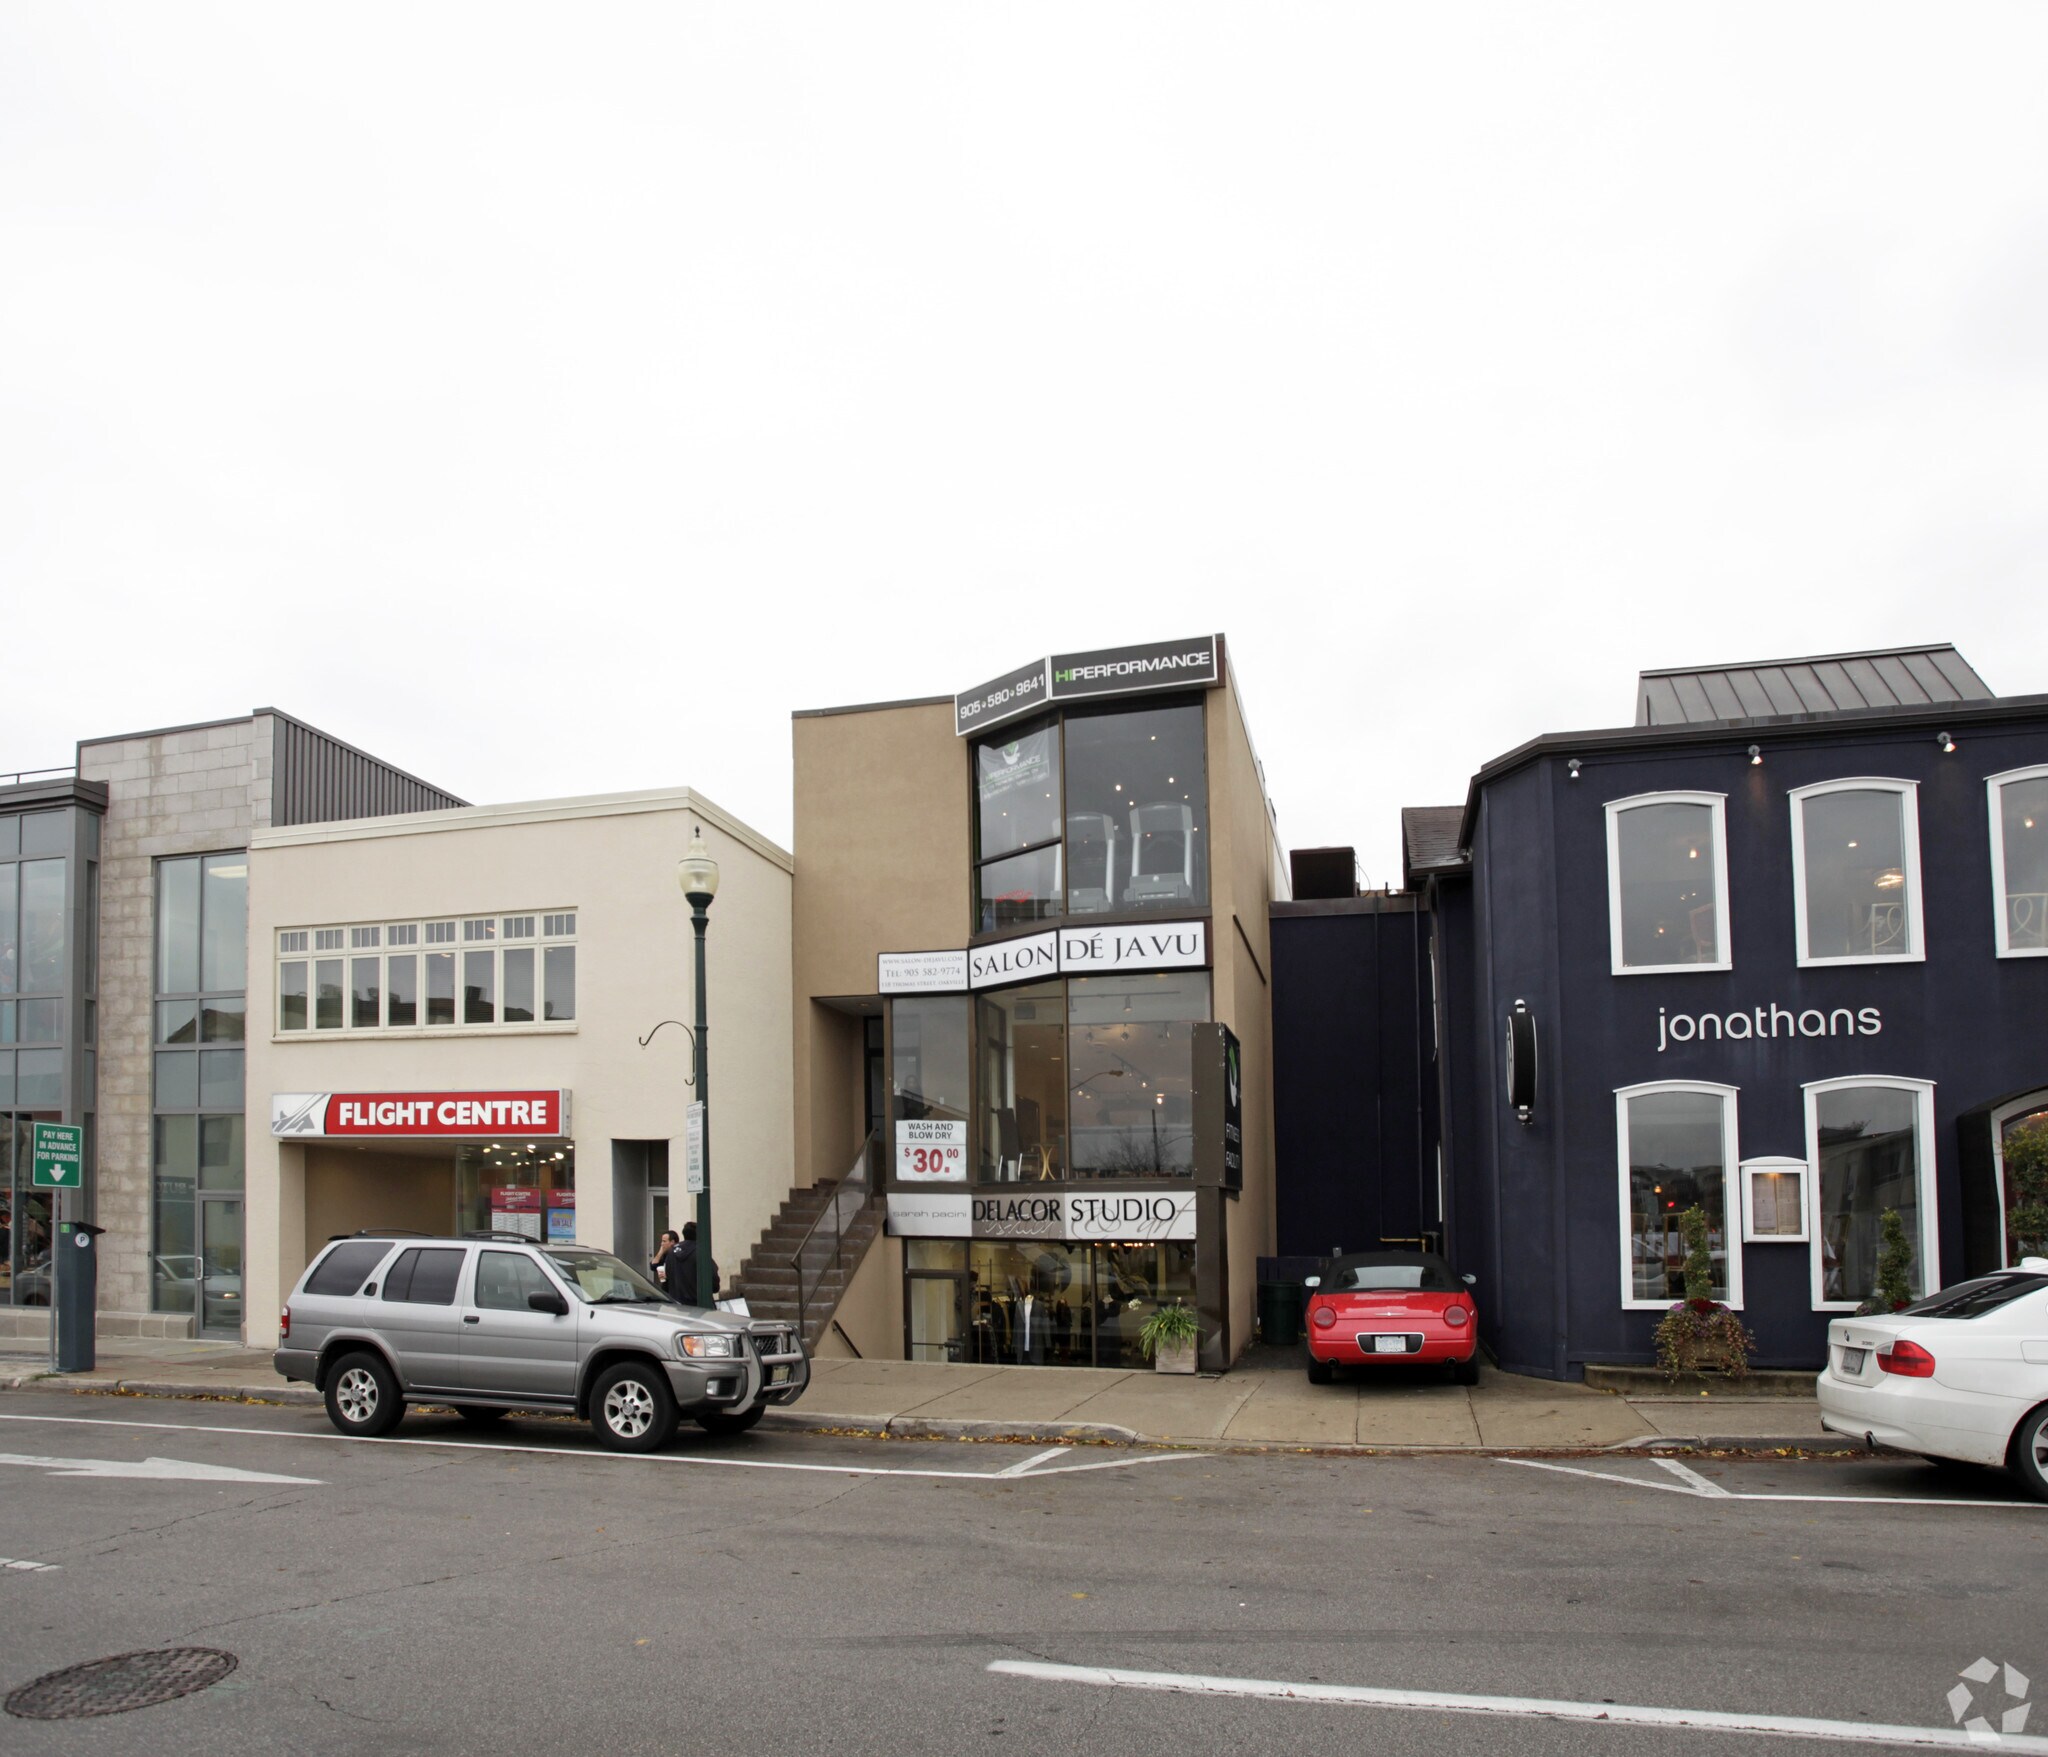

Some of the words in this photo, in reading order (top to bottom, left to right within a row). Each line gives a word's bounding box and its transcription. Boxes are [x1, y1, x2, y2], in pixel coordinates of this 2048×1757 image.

[1055, 651, 1210, 682] HIPERFORMANCE
[973, 942, 1054, 978] SALON
[1065, 932, 1104, 960] DÉ
[1114, 934, 1198, 964] JAVU
[904, 968, 919, 977] 905
[922, 966, 960, 976] 582-9774
[1657, 1003, 1882, 1052] jonathans
[339, 1102, 434, 1126] FLIGHT
[436, 1100, 547, 1125] CENTRE
[908, 1122, 933, 1130] WASH
[935, 1122, 954, 1131] AND
[43, 1131, 56, 1139] PAY
[56, 1131, 74, 1141] HERE
[908, 1131, 933, 1139] BLOW
[935, 1131, 952, 1139] DRY
[39, 1141, 47, 1149] IN
[48, 1142, 77, 1152] ADVANCE
[37, 1151, 50, 1160] FOR
[51, 1152, 79, 1162] PARKING
[892, 1210, 929, 1218] sarah
[932, 1210, 967, 1219] pacini
[972, 1199, 1061, 1221] DELACOR
[1071, 1198, 1176, 1222] STUDIO
